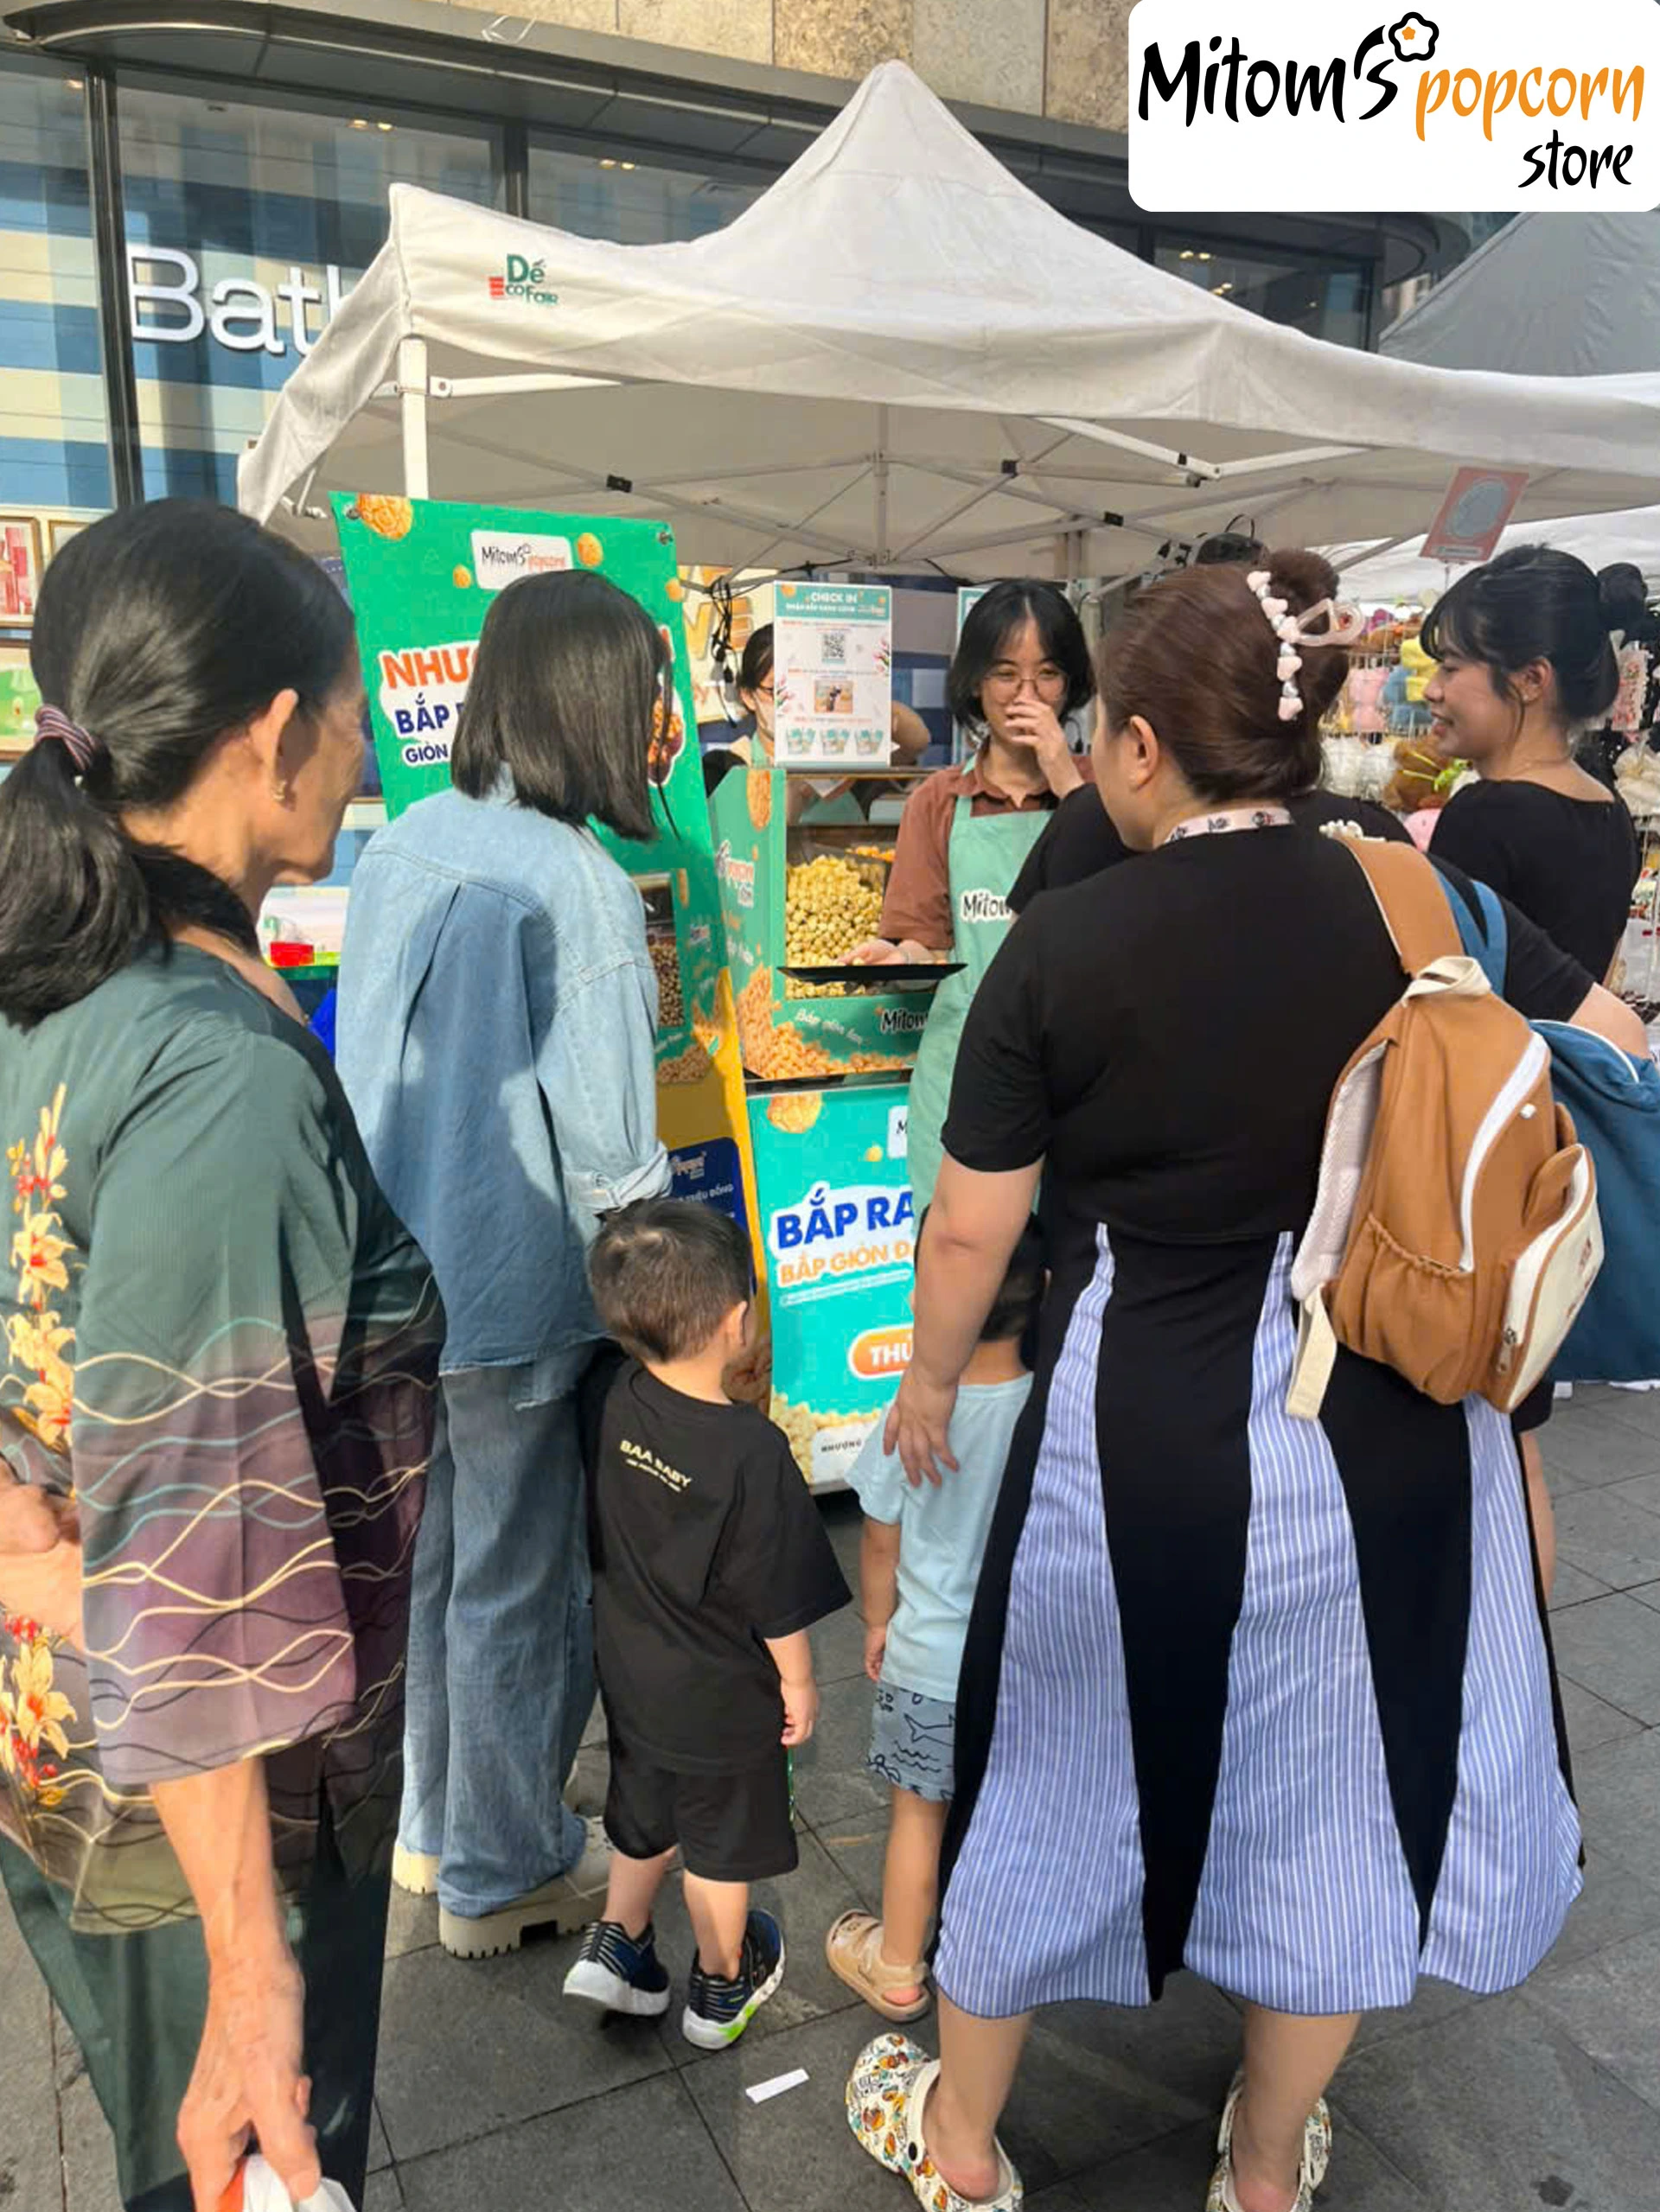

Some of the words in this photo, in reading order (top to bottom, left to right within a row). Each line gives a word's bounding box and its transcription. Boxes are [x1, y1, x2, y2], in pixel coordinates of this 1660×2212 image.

[395, 692, 450, 735] BẮP
[776, 1188, 859, 1249] BẮP
[620, 1439, 653, 1463] BAA
[654, 1457, 692, 1487] BABY
